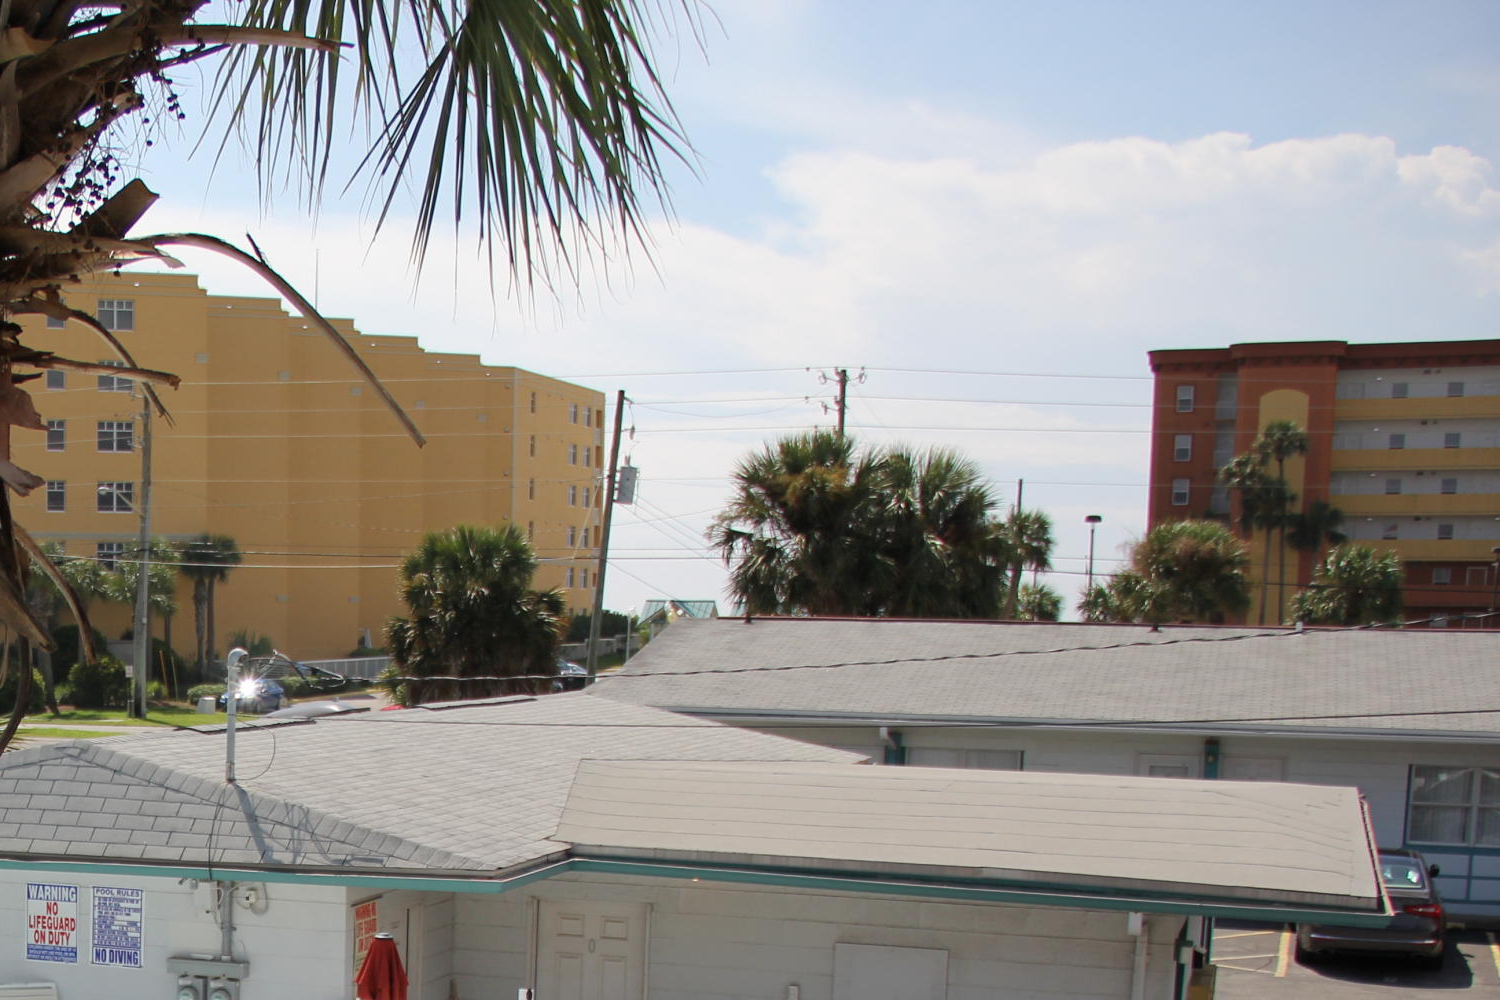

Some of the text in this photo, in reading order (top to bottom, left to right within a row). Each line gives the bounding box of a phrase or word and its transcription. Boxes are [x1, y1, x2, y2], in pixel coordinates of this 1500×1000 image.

[28, 885, 76, 901] WARNING
[46, 902, 58, 915] NO
[29, 915, 76, 931] LIFEGUARD
[34, 931, 70, 945] ON DUTY
[95, 949, 138, 965] NO DIVING
